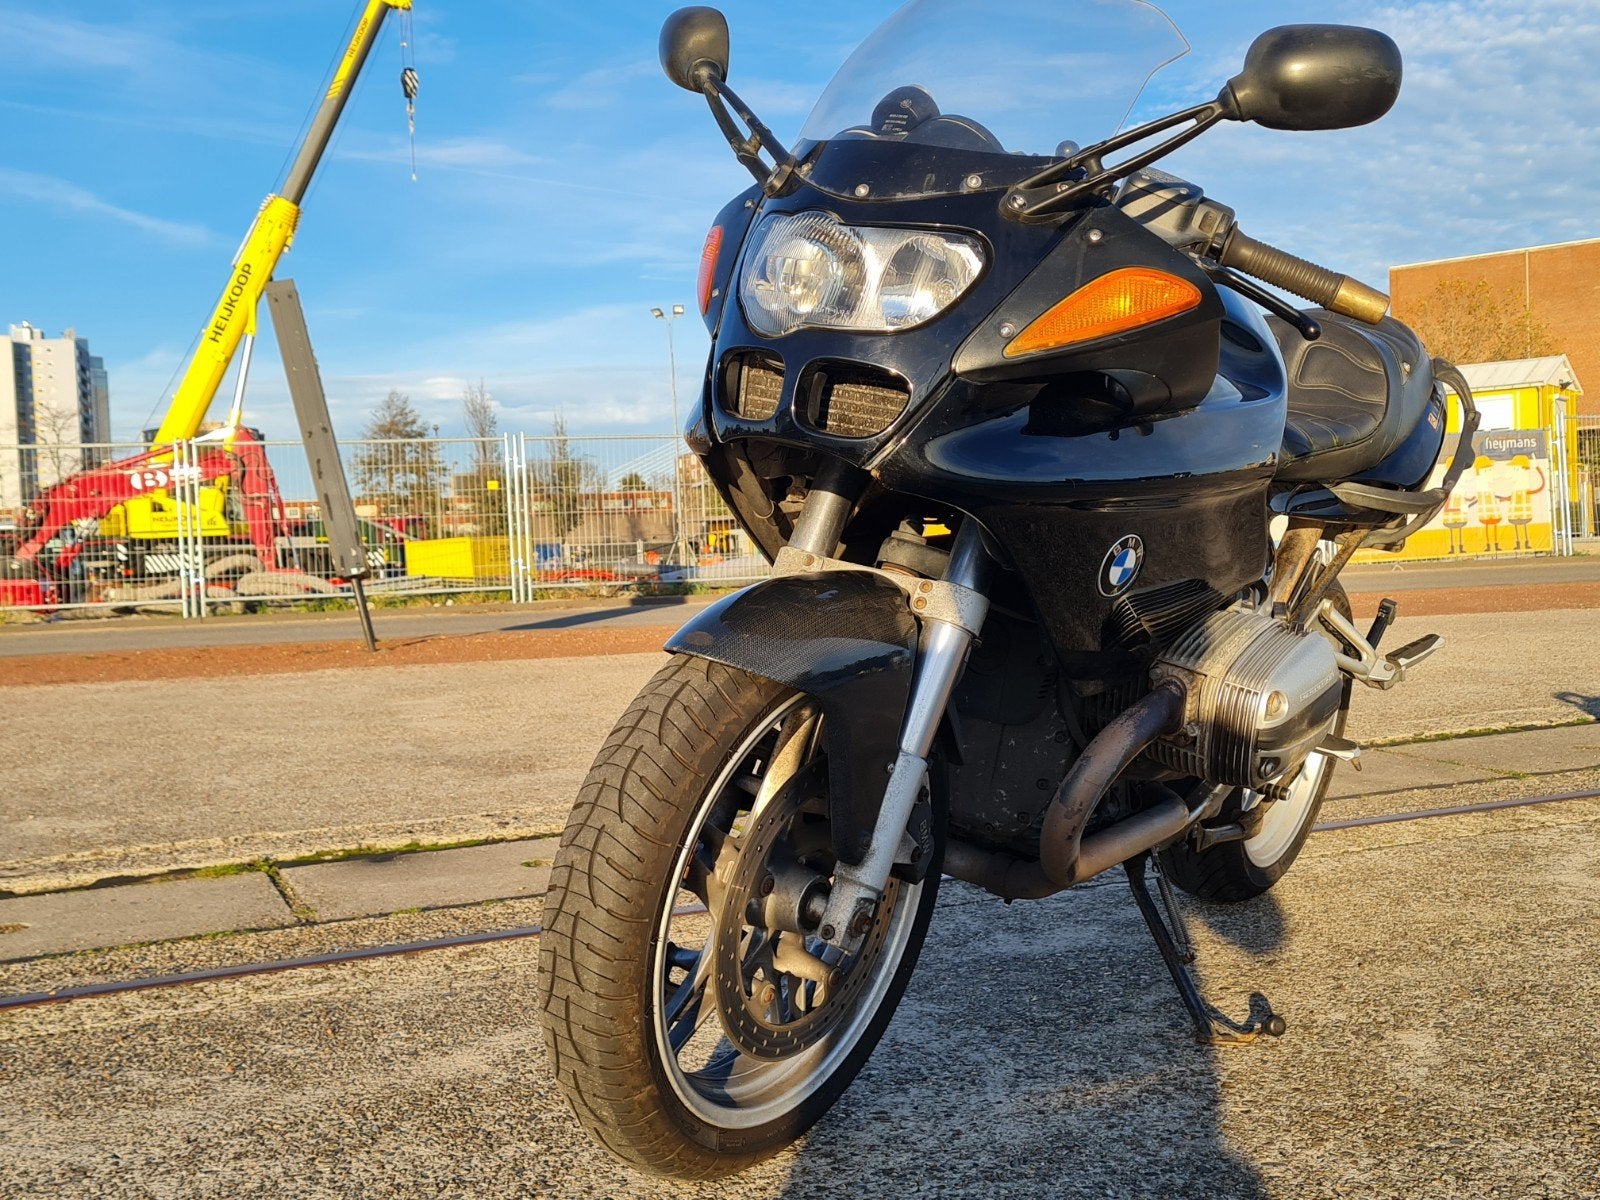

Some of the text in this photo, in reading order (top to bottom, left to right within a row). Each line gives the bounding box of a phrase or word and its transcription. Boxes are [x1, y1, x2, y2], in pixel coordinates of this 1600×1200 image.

[209, 263, 251, 343] HEIJKOOP
[1113, 537, 1143, 561] BMW
[919, 819, 931, 854] BMW
